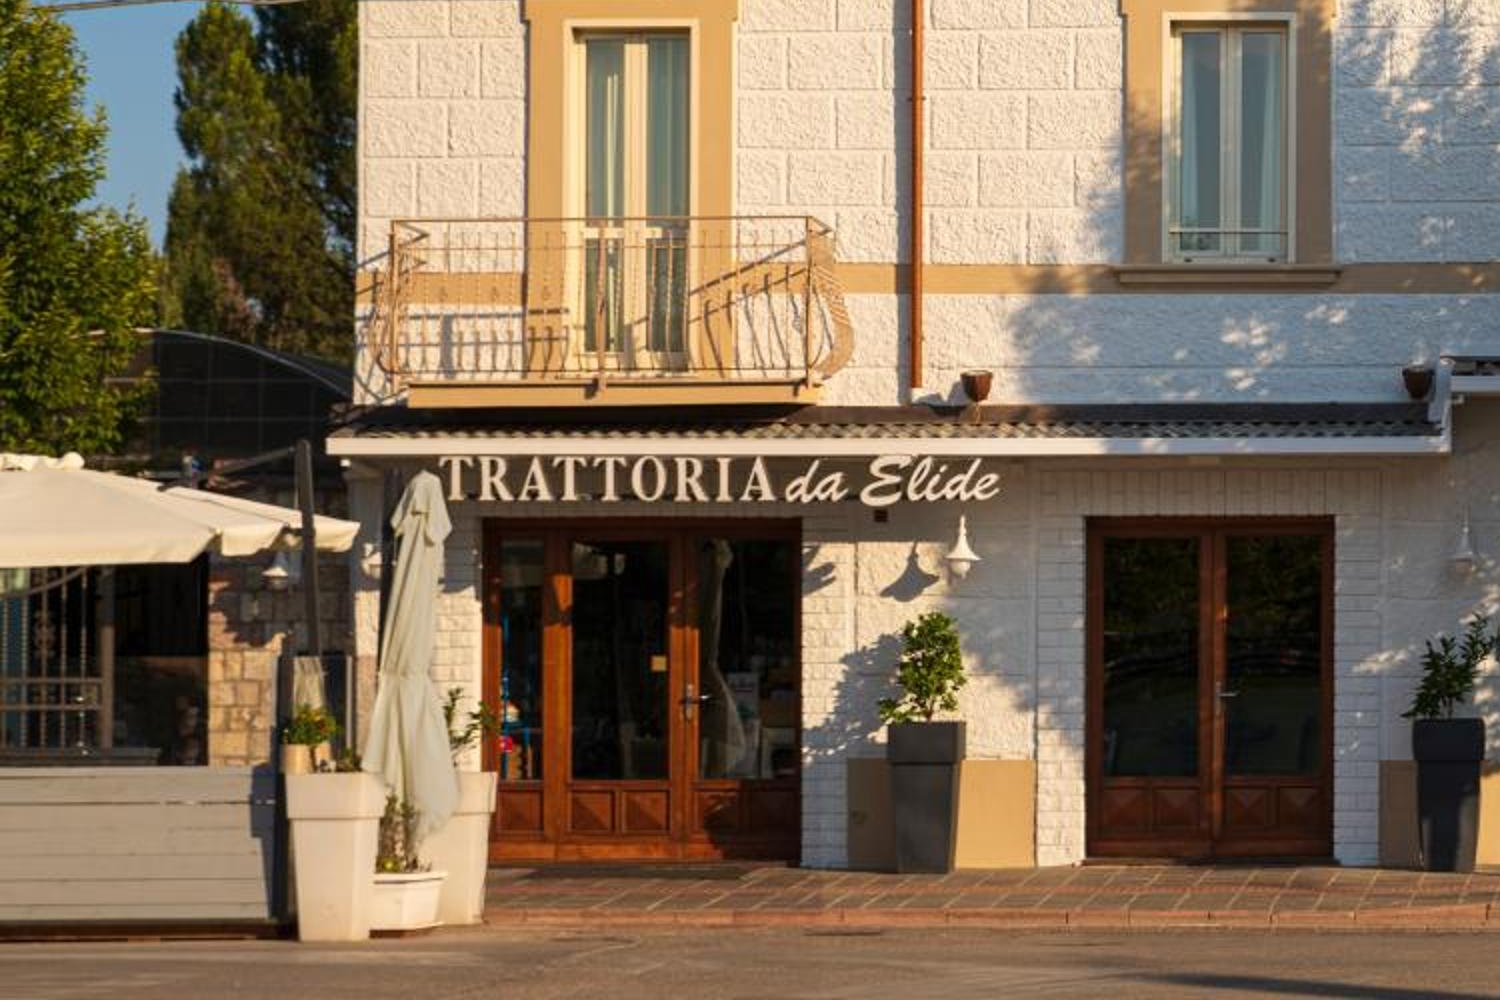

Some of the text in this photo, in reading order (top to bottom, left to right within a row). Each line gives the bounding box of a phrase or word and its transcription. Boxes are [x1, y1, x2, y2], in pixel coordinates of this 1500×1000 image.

[438, 453, 1000, 507] TRATTORIA da Elide
